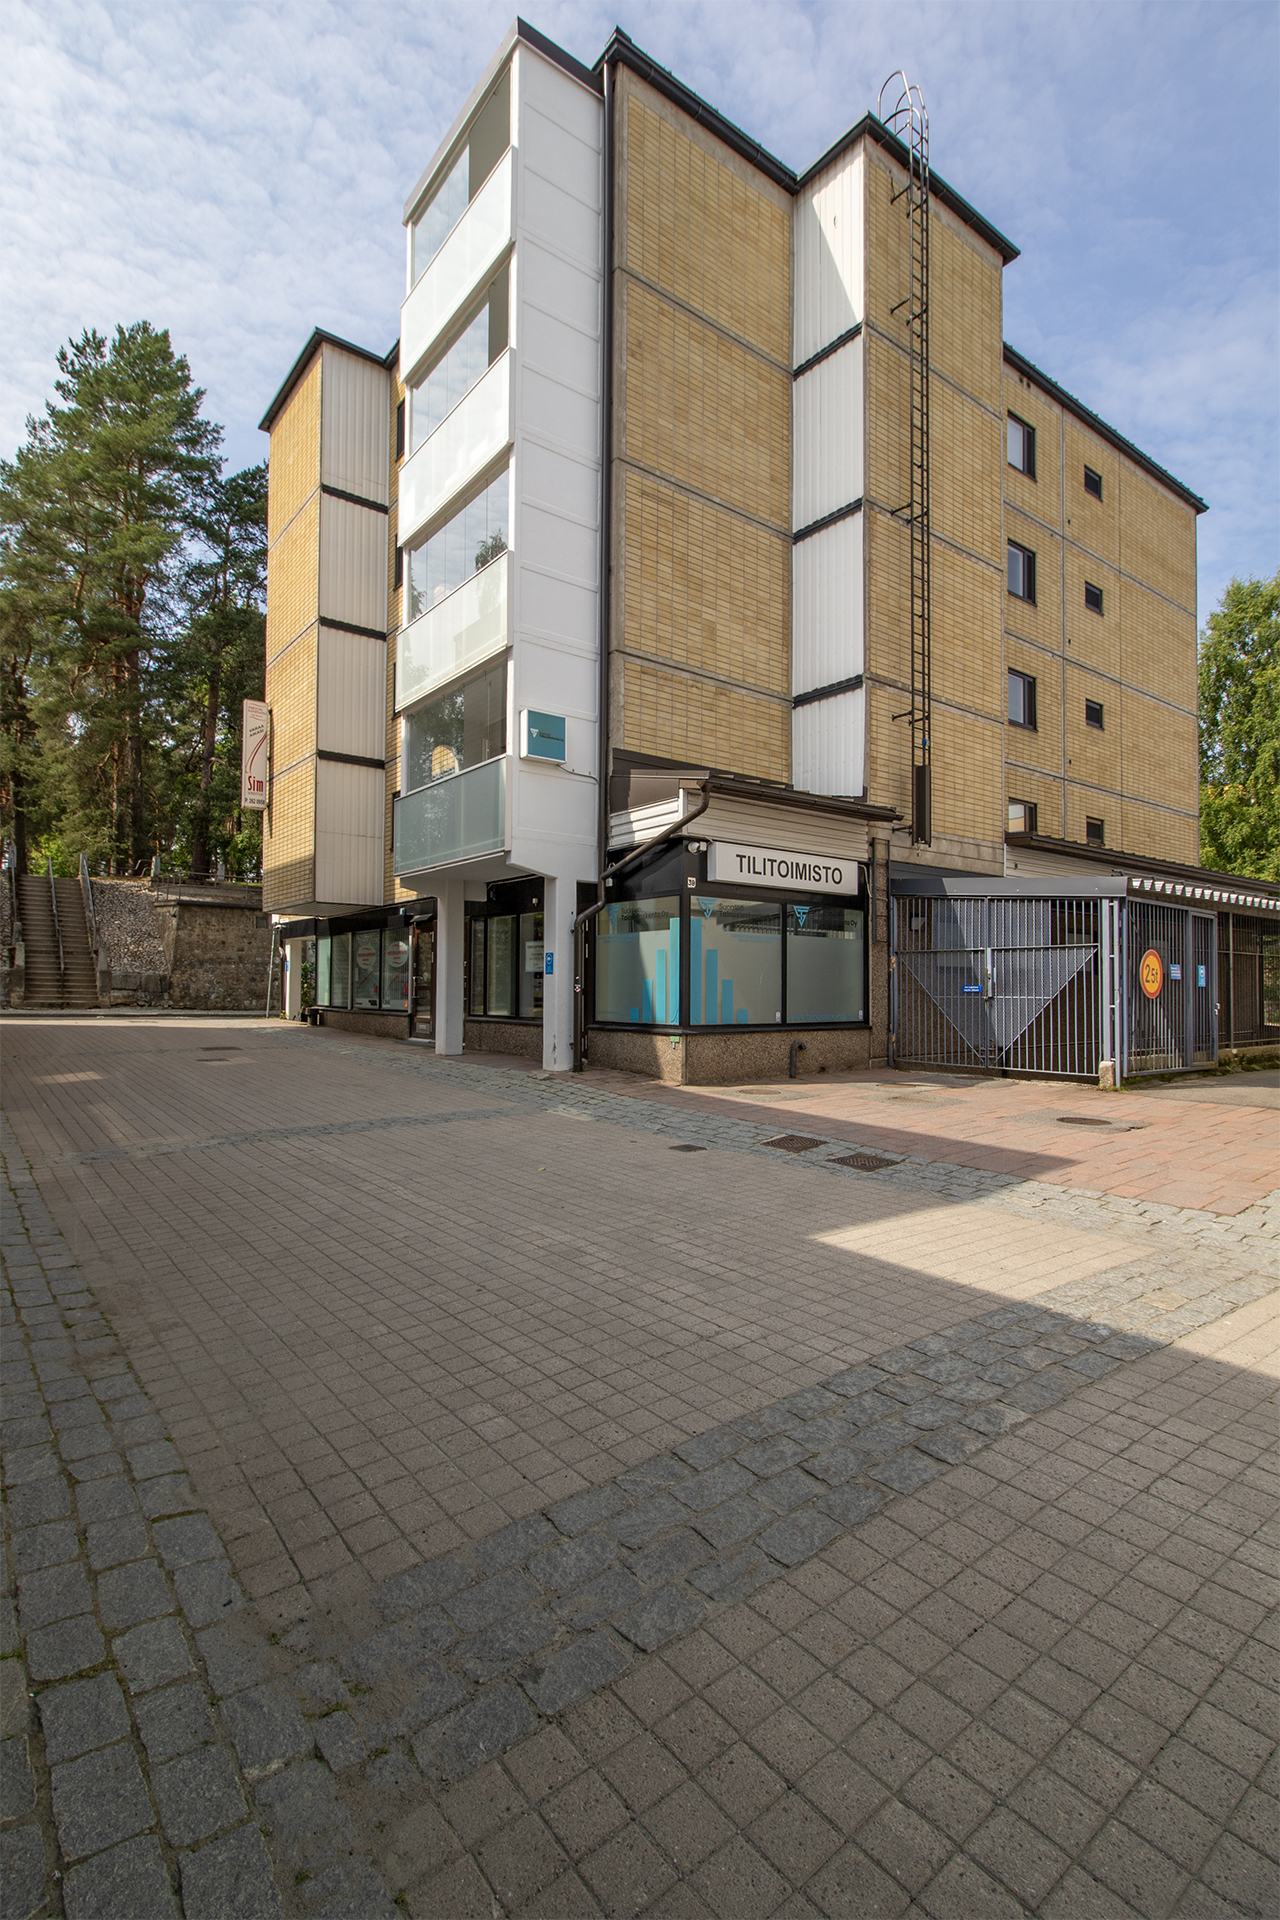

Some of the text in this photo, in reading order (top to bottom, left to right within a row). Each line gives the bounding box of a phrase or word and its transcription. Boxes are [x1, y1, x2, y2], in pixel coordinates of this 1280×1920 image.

[248, 775, 263, 792] Sim
[736, 854, 842, 885] TILITOIMISTO
[661, 910, 669, 918] Oy
